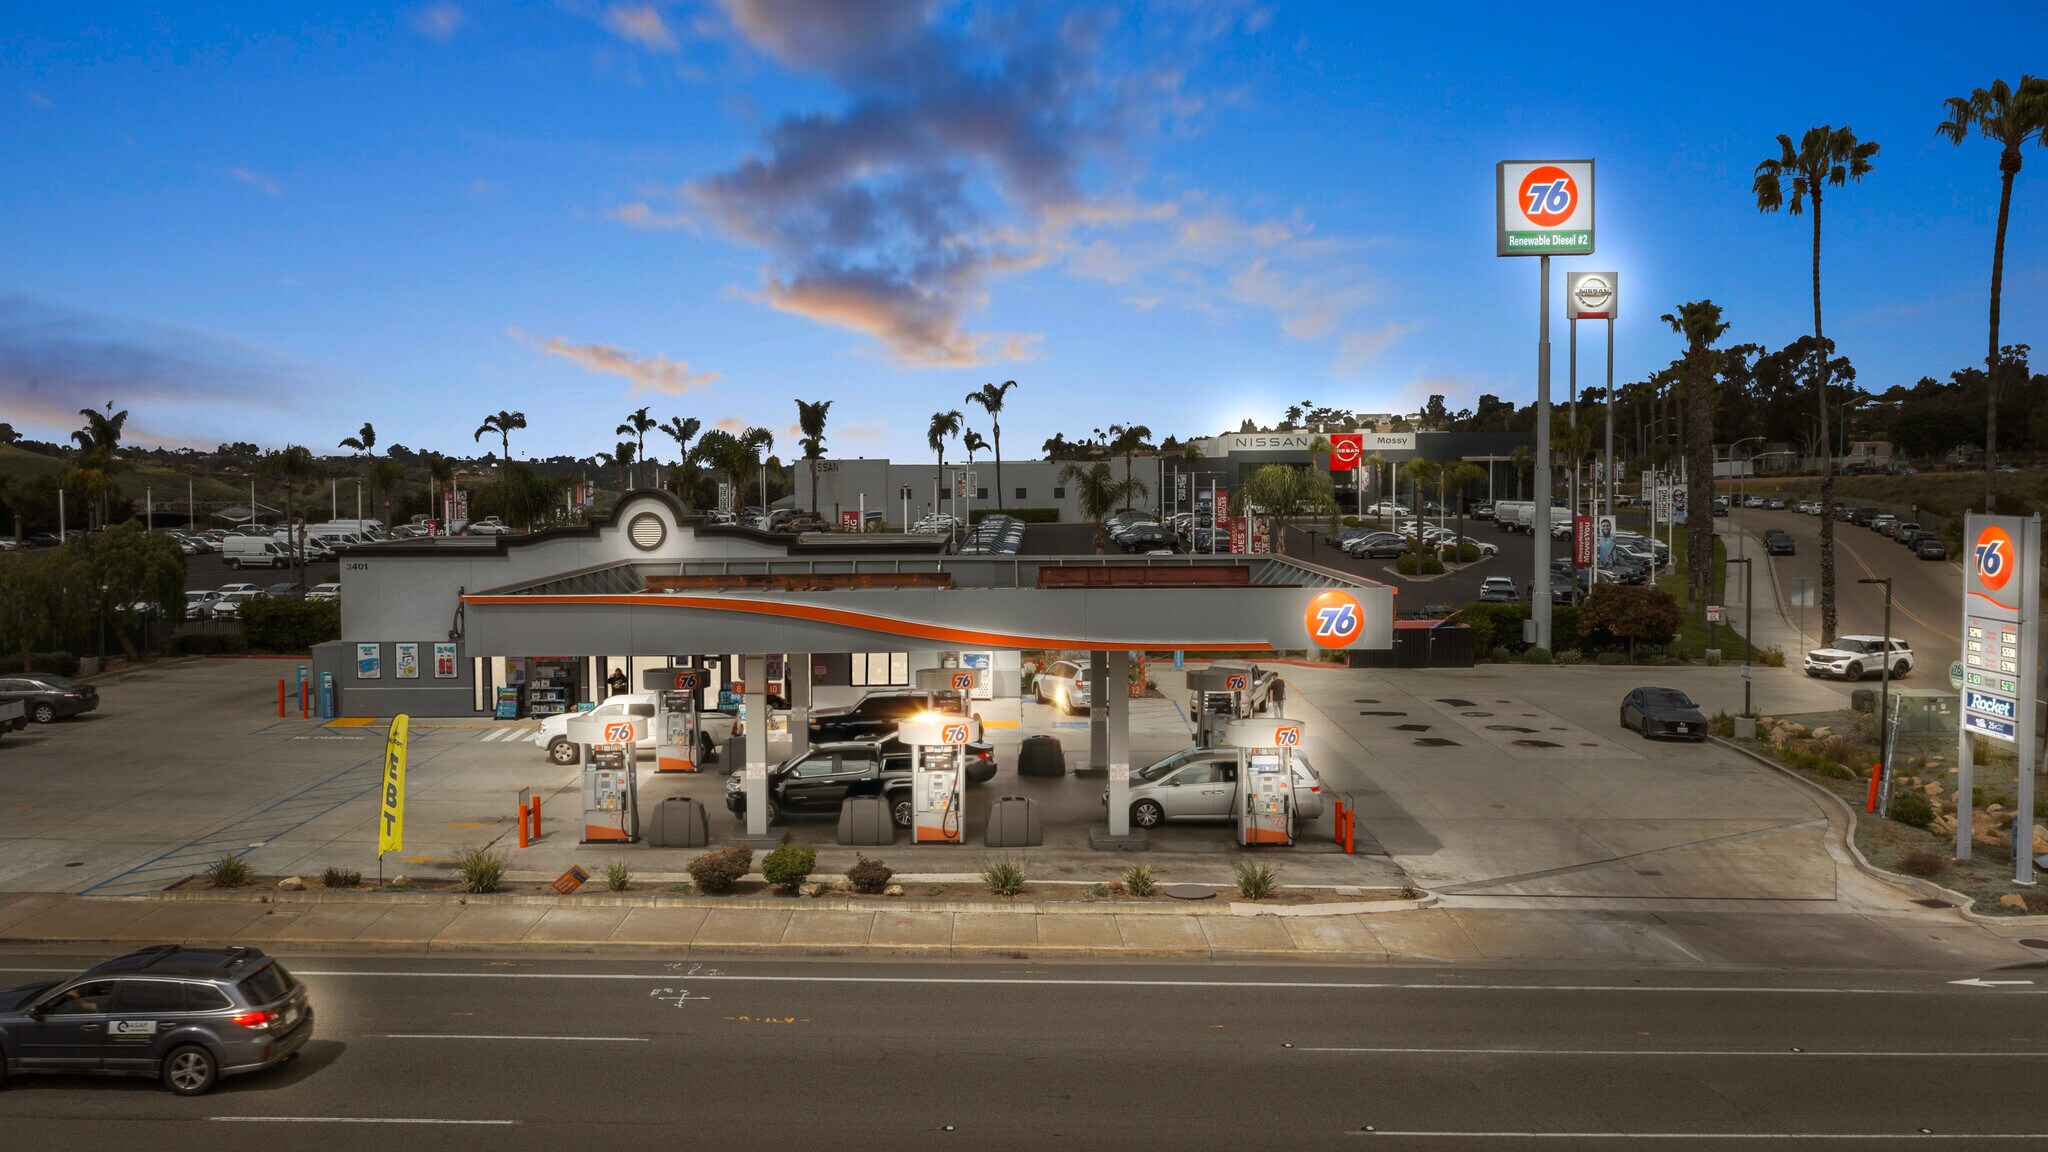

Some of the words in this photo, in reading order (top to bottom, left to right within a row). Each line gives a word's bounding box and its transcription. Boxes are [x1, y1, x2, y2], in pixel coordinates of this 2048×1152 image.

[1527, 178, 1570, 215] 76
[1509, 234, 1551, 247] Renewable
[1552, 234, 1576, 246] Diesel
[1577, 234, 1588, 245] #2
[1578, 287, 1610, 296] NISSAN
[1235, 437, 1308, 447] NISSAN
[1376, 436, 1408, 446] Mossy
[809, 463, 839, 473] NSSAN
[1583, 521, 1591, 563] MovesYou
[1975, 539, 2005, 578] 76
[346, 563, 368, 571] 3401
[1316, 603, 1358, 637] 76
[679, 673, 697, 688] 76
[955, 673, 971, 688] 76
[1229, 675, 1245, 690] 76
[1131, 686, 1141, 694] 12
[1970, 693, 2011, 716] Rocket
[608, 722, 633, 742] 76
[945, 725, 967, 743] 76
[1279, 727, 1297, 745] 76
[383, 752, 399, 837] EBT
